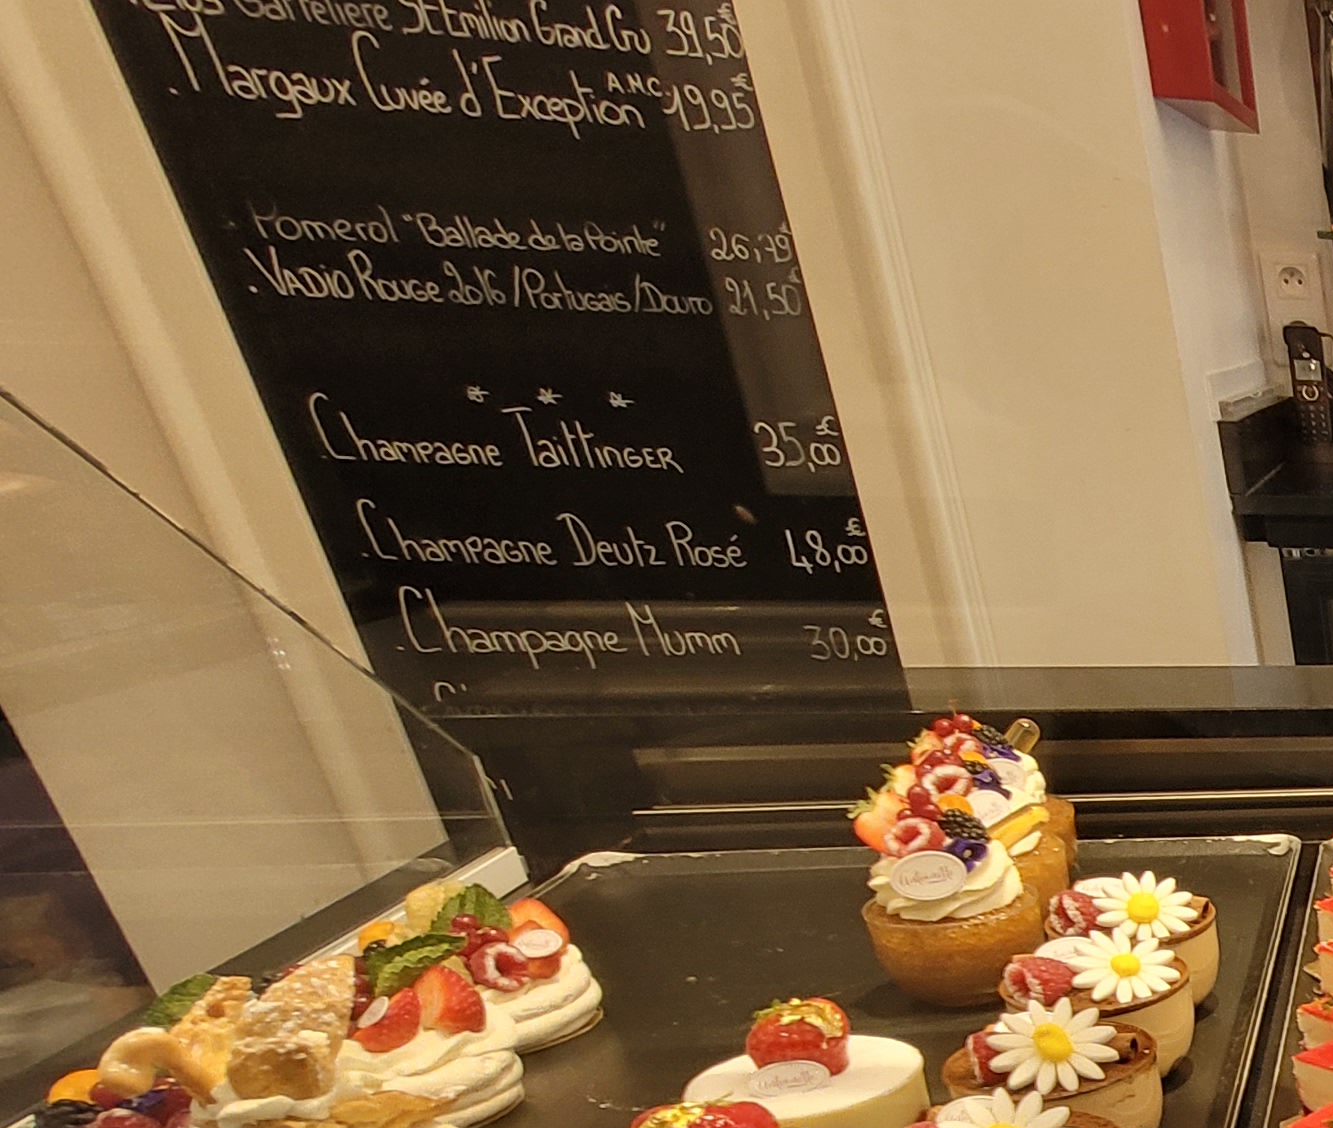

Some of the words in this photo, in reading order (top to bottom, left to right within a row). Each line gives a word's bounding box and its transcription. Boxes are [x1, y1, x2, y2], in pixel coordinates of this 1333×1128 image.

[530, 0, 611, 50] Grand
[605, 4, 651, 54] Cru
[158, 8, 357, 119] Margaux
[351, 30, 453, 113] Cuvée
[556, 512, 667, 568] Deutz
[665, 520, 748, 568] Rosé
[625, 601, 742, 656] Mumm
